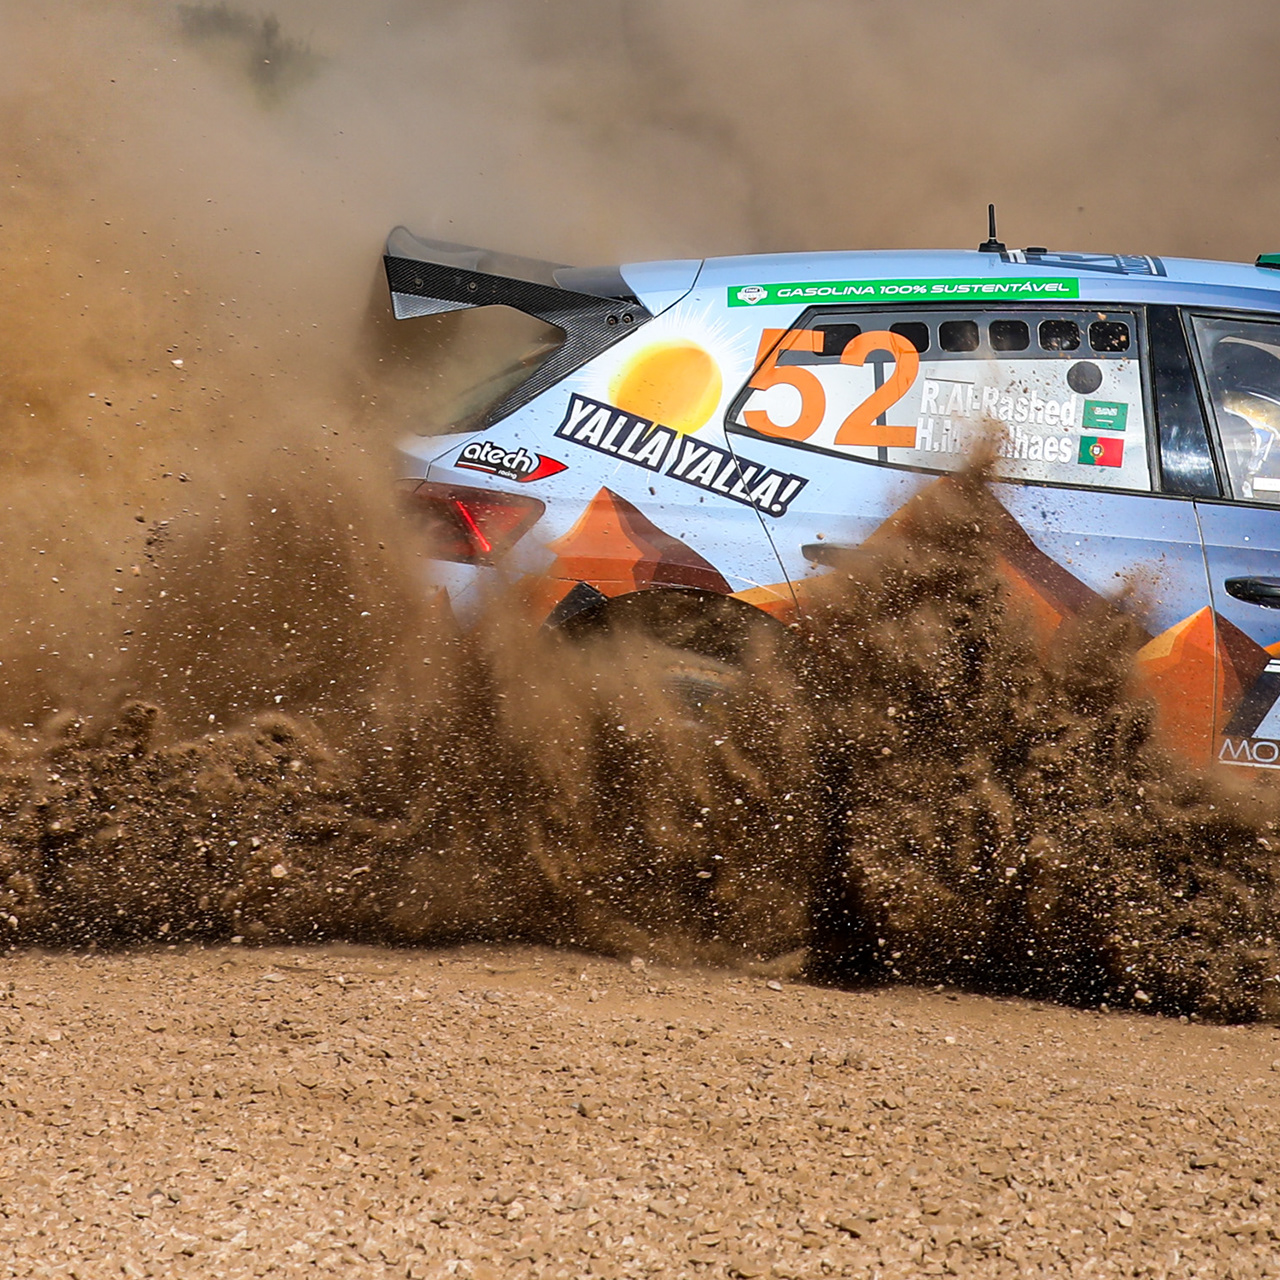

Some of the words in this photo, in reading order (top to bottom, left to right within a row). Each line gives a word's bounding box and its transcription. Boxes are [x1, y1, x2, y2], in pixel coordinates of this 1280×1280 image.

[776, 284, 874, 298] GASOLINA
[879, 283, 927, 295] 100%
[930, 280, 1070, 294] SUSTENTÁVEL
[743, 328, 919, 447] 52
[463, 442, 532, 473] atech
[561, 398, 671, 468] YALLA
[673, 439, 803, 513] YALLA!
